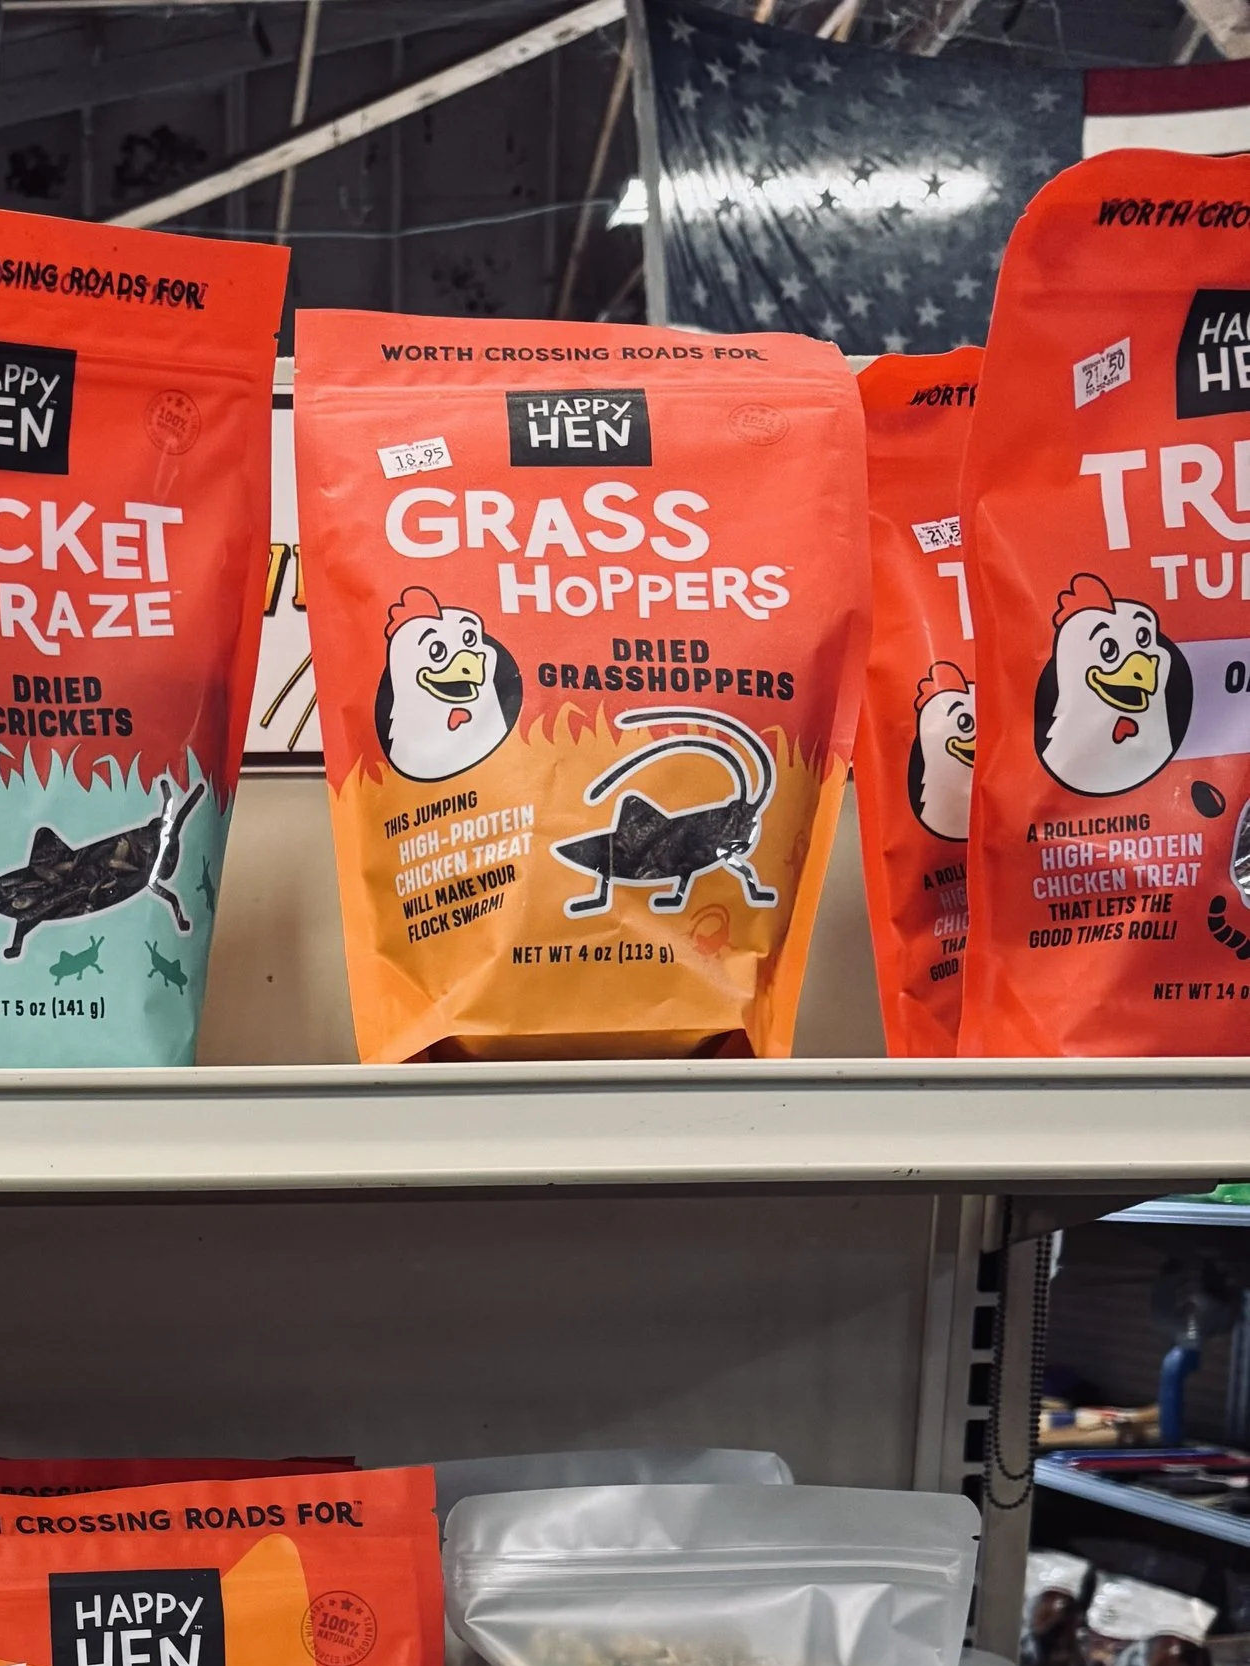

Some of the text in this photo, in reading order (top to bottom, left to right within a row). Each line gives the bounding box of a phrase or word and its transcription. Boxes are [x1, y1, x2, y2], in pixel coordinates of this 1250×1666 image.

[527, 399, 632, 422] HAPPY
[528, 416, 631, 452] HEN
[395, 447, 444, 469] 18.95
[385, 482, 710, 561] GRASS
[499, 563, 790, 621] HOPPERS
[613, 639, 709, 664] DRIED
[13, 675, 101, 703] DRIED
[539, 664, 795, 701] GRASSHOPPERS
[398, 804, 535, 867] HIGH-PROTEIN
[1027, 814, 1150, 842] A ROLLICKING
[395, 832, 534, 898] CHICKEN TREAT
[1042, 833, 1203, 870] HIGH-PROTEIN
[1033, 863, 1201, 899] CHICKEN TREAT
[1049, 894, 1172, 920] THAT LETS THE
[15, 1509, 172, 1534] CROSSING
[186, 1505, 286, 1531] ROADS
[298, 1502, 363, 1527] FOR
[75, 1593, 203, 1636] HAPPY
[319, 1613, 359, 1637] 100%
[317, 1629, 354, 1648] NATURAL
